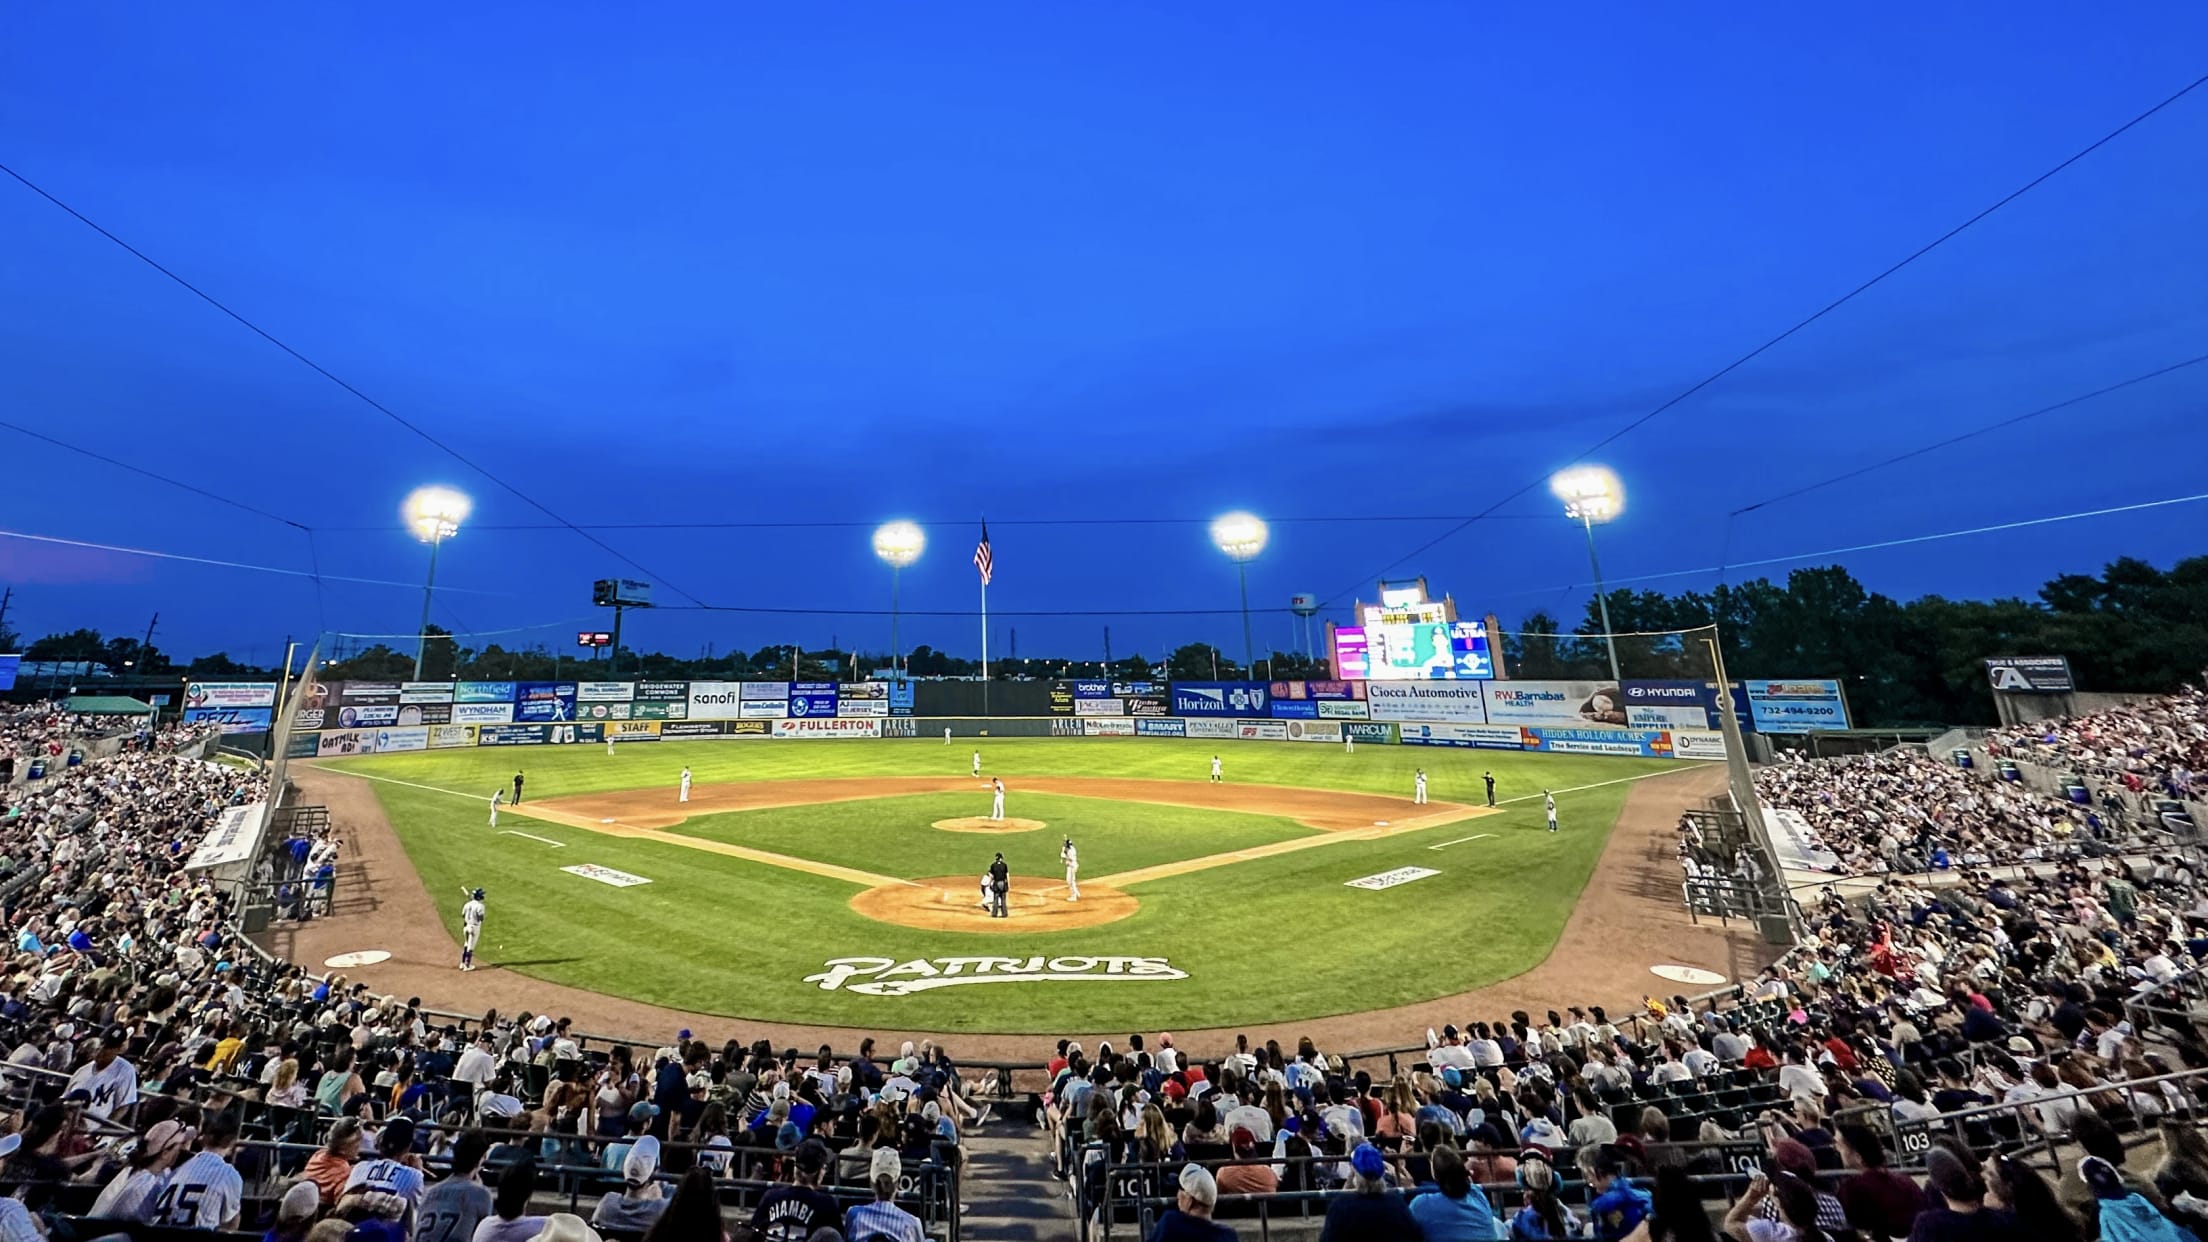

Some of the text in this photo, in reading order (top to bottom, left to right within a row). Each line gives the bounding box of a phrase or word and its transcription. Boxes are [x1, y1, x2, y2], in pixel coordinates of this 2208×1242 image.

[461, 683, 511, 694] Northfield
[1079, 684, 1107, 692] brother
[1370, 685, 1408, 698] Ciocca
[1408, 685, 1478, 698] Automotive
[1647, 688, 1696, 697] HYUNDAI
[693, 692, 735, 704] sanofi
[1495, 690, 1566, 702] RWJBarnabas
[459, 706, 506, 714] WYNDHAM
[1178, 697, 1225, 711] Horizon
[1761, 706, 1834, 715] 732-494-9200
[622, 723, 650, 732] STAFF
[800, 721, 874, 730] FULLERTON
[885, 719, 916, 730] ARLEN
[1148, 723, 1184, 731] SMART
[1349, 725, 1392, 735] MARCUM
[1542, 729, 1647, 741] HIDDEN HOLLOW ACRES
[1605, 744, 1640, 752] Landscape
[803, 955, 1178, 992] PATRIOTS
[1902, 1132, 1930, 1152] 103
[367, 1161, 401, 1183] COLE
[1118, 1178, 1151, 1197] 101
[154, 1183, 208, 1226] 45
[769, 1200, 814, 1225] GIAMBI
[415, 1212, 460, 1242] 27
